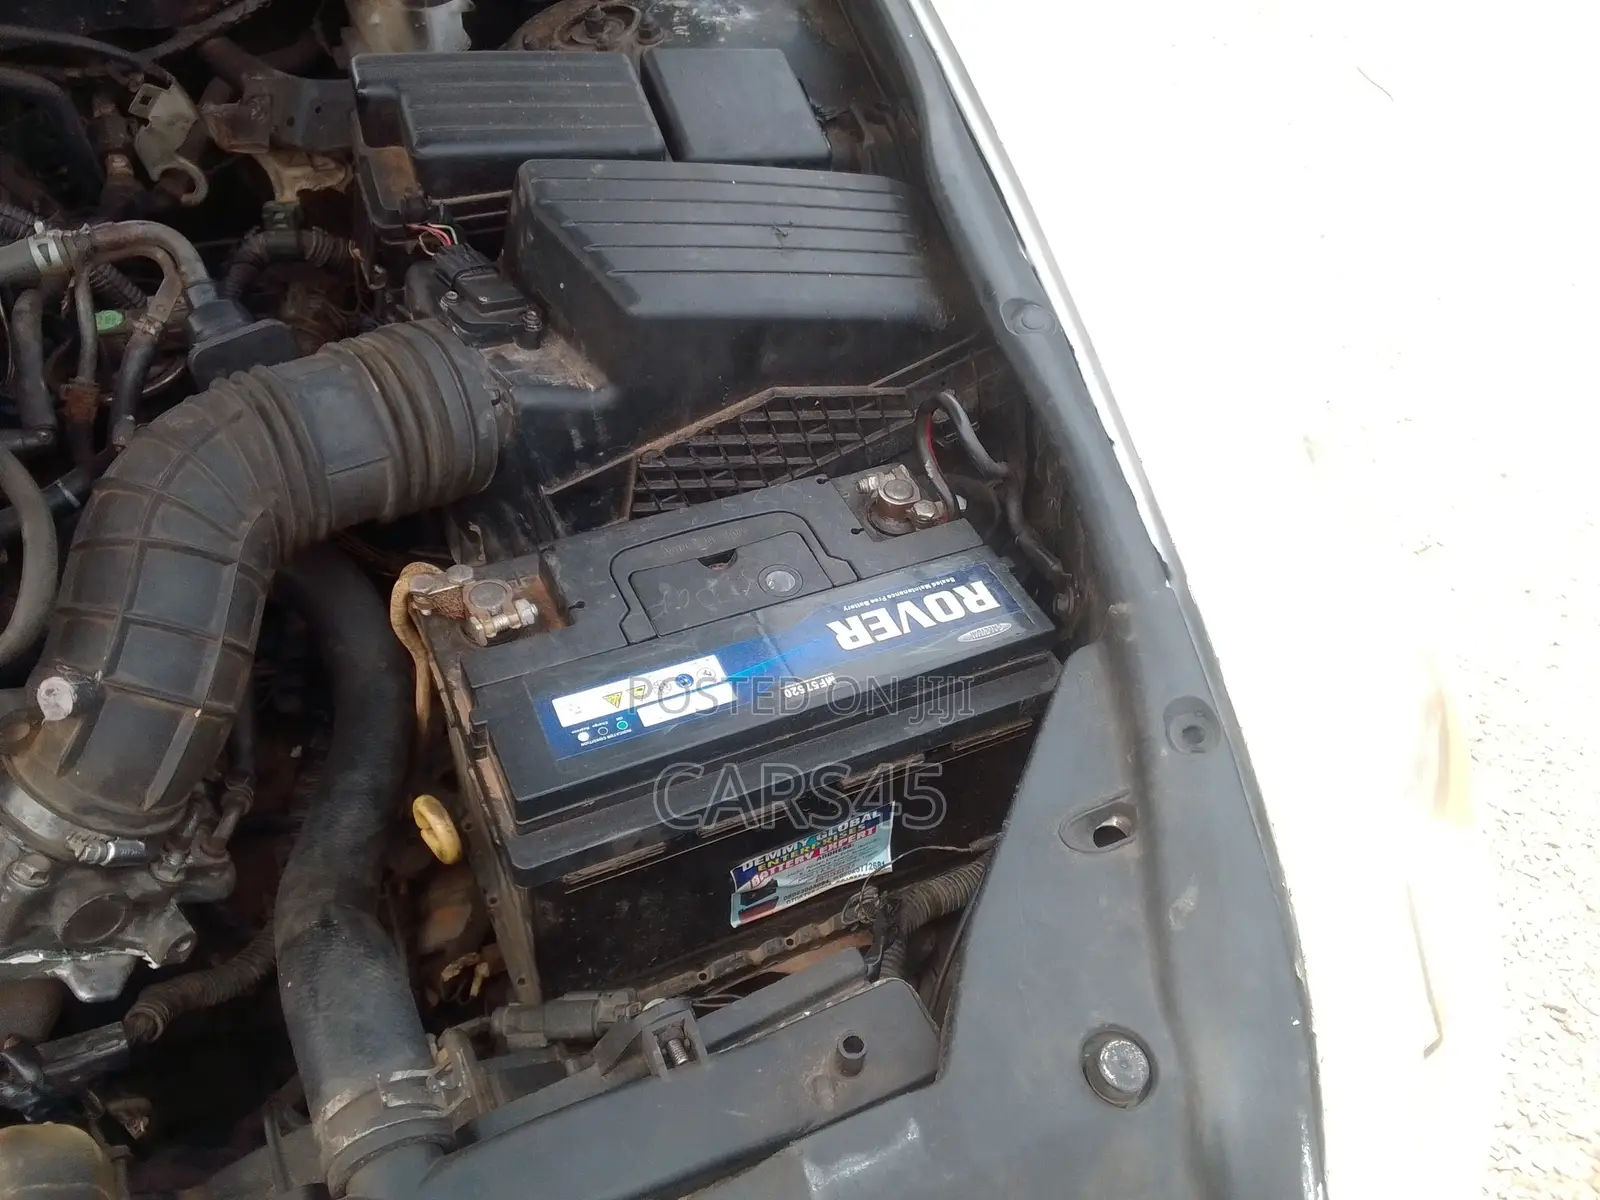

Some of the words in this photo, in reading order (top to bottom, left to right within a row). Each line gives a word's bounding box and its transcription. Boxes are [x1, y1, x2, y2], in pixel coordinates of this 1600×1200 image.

[870, 593, 888, 604] Free
[888, 582, 932, 600] Maintenance
[931, 577, 956, 589] Sealed
[826, 580, 1001, 650] ROVER
[843, 598, 870, 611] Battery
[741, 836, 811, 872] DEMMY
[816, 810, 881, 841] GLOBAL
[757, 824, 866, 872] ENTERPRISES
[751, 851, 815, 889] BATTERY
[819, 827, 876, 854] EXPERT
